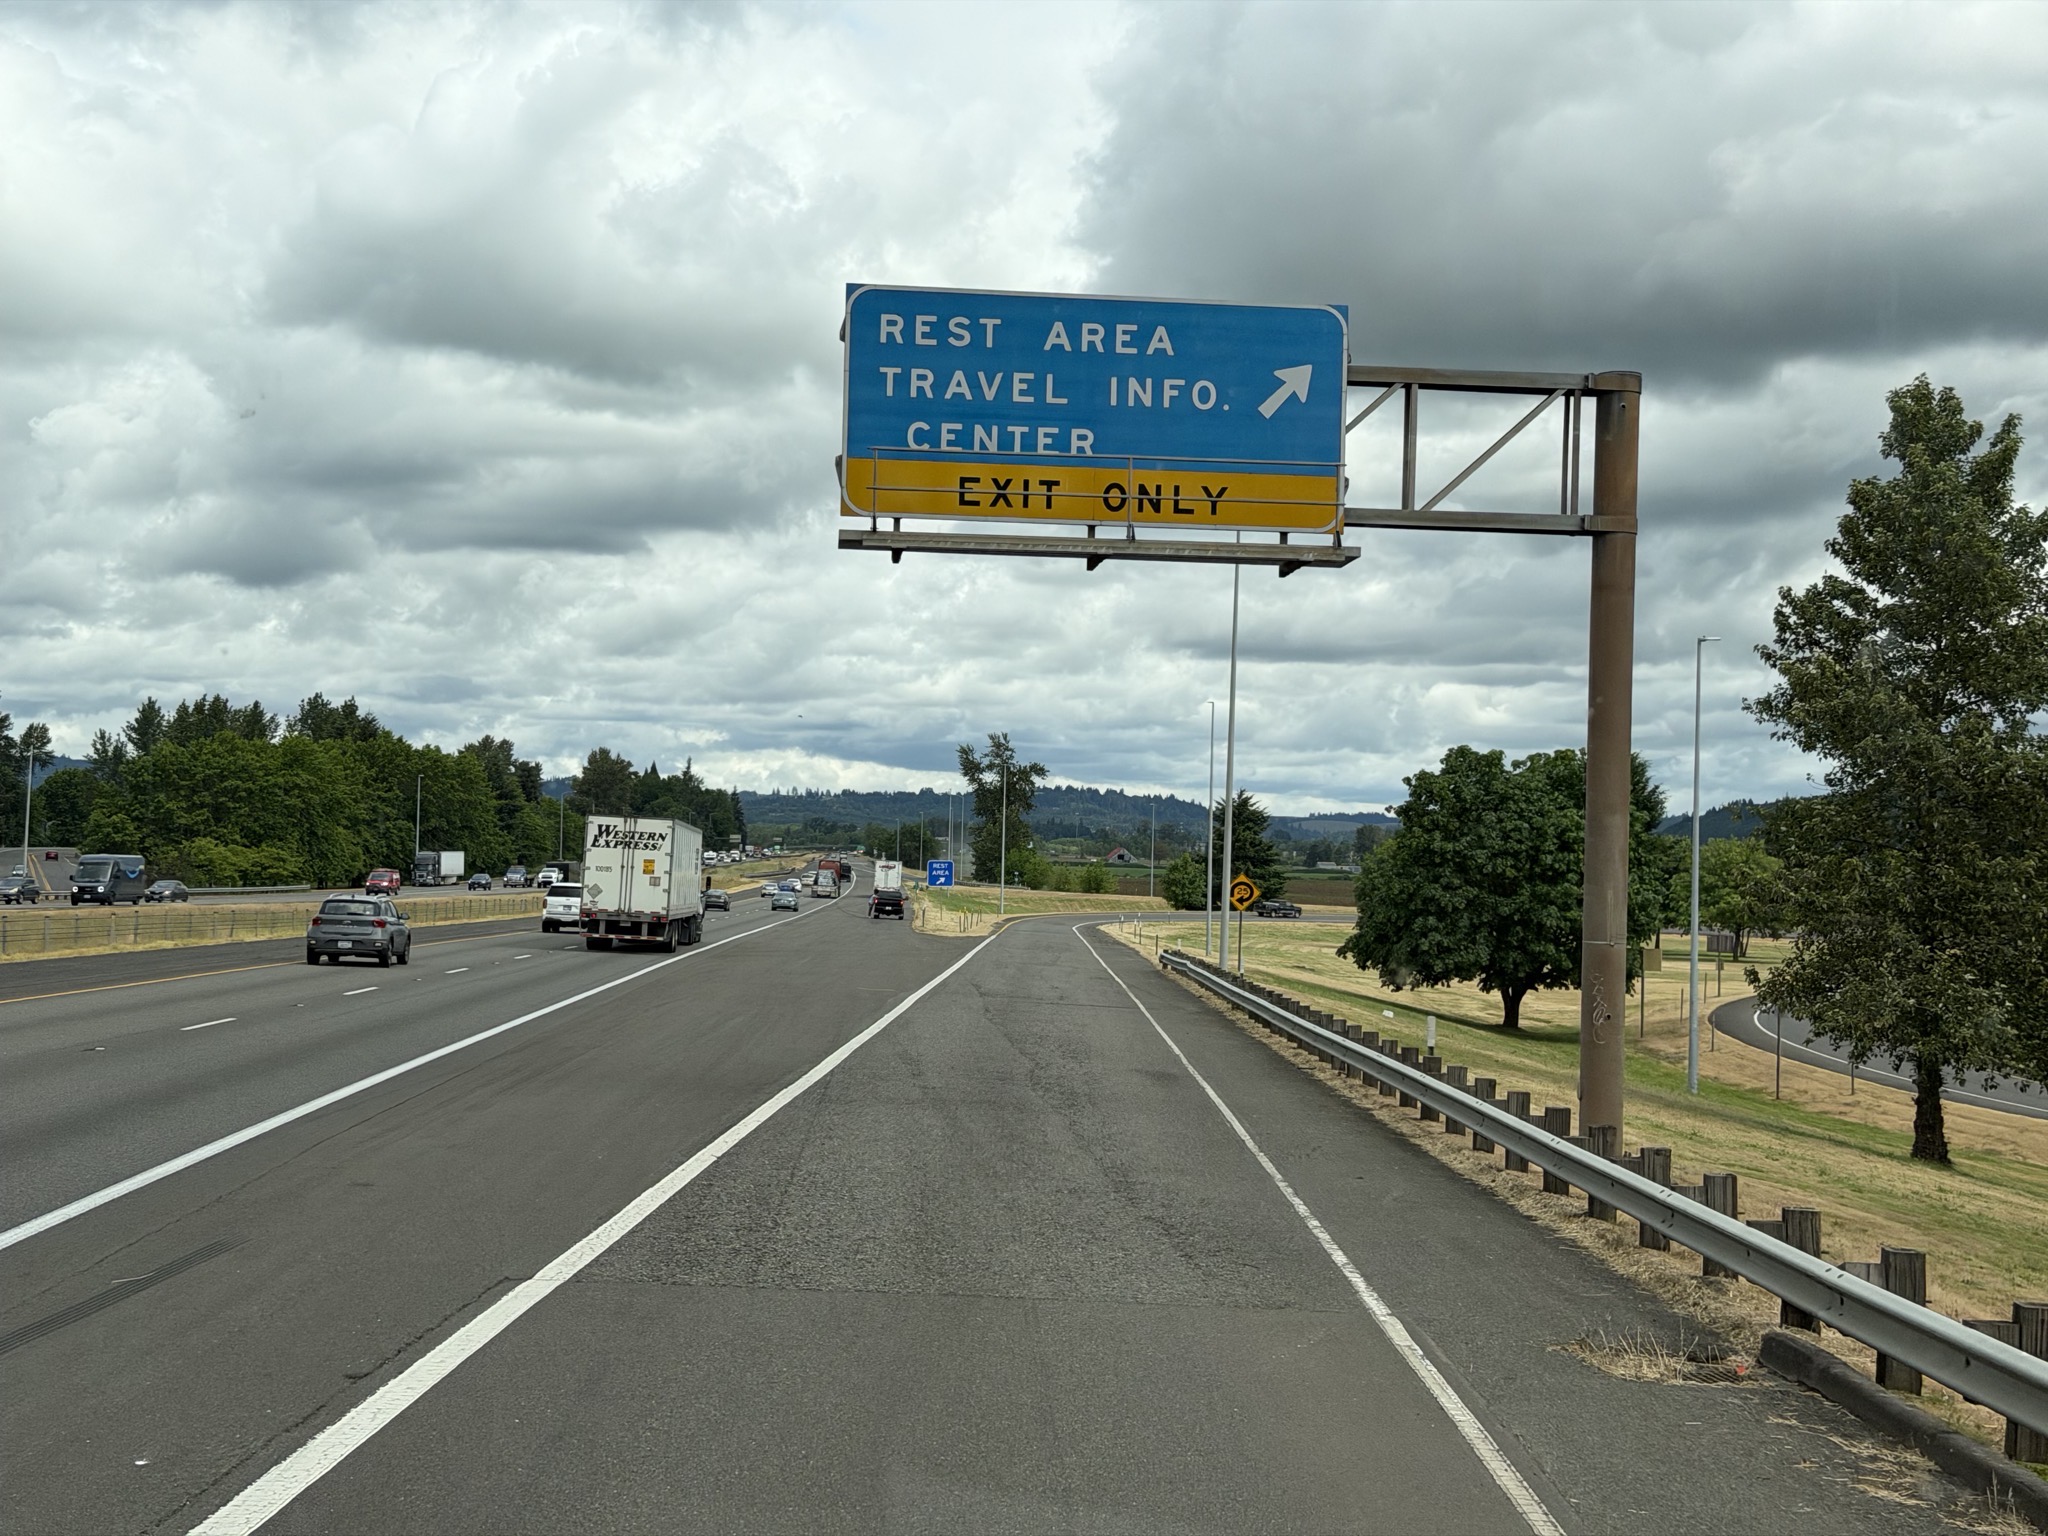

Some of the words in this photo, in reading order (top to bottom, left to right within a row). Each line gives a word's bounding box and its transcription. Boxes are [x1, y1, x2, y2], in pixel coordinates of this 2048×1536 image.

[880, 313, 1002, 349] REST
[1044, 320, 1175, 356] AREA
[879, 366, 1069, 404] TRAVEL
[1110, 376, 1231, 411] INFO.
[907, 420, 1095, 456] CENTER
[958, 475, 1061, 510] EXIT
[1102, 481, 1229, 516] ONLY
[590, 834, 659, 851] EXPRESS
[597, 824, 668, 842] WESTERN
